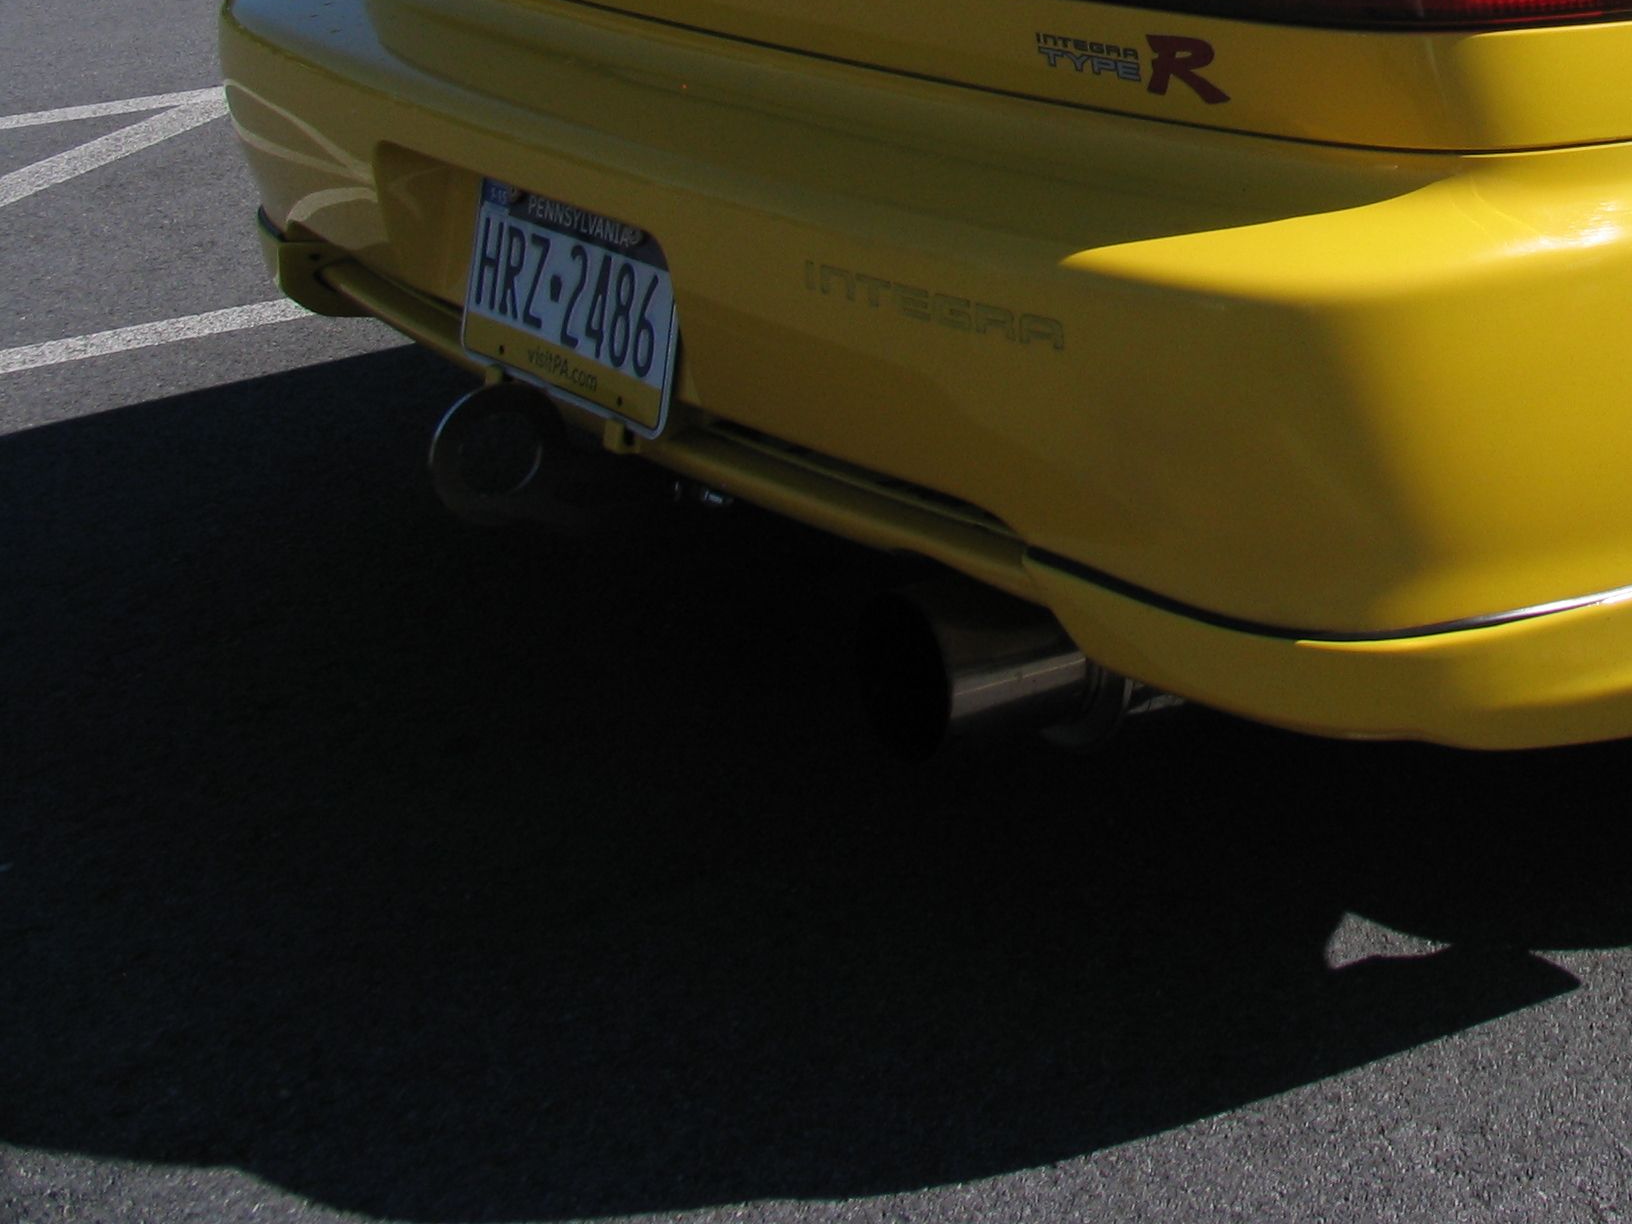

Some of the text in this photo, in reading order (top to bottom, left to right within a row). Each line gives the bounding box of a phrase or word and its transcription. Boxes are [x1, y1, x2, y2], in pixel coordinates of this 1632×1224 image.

[1035, 32, 1140, 60] INTEGRA
[1038, 33, 1232, 105] TYPE R
[527, 194, 633, 248] PENNSYLVANIA
[805, 259, 1065, 352] INTEGRA
[527, 346, 598, 393] visitPA.com
